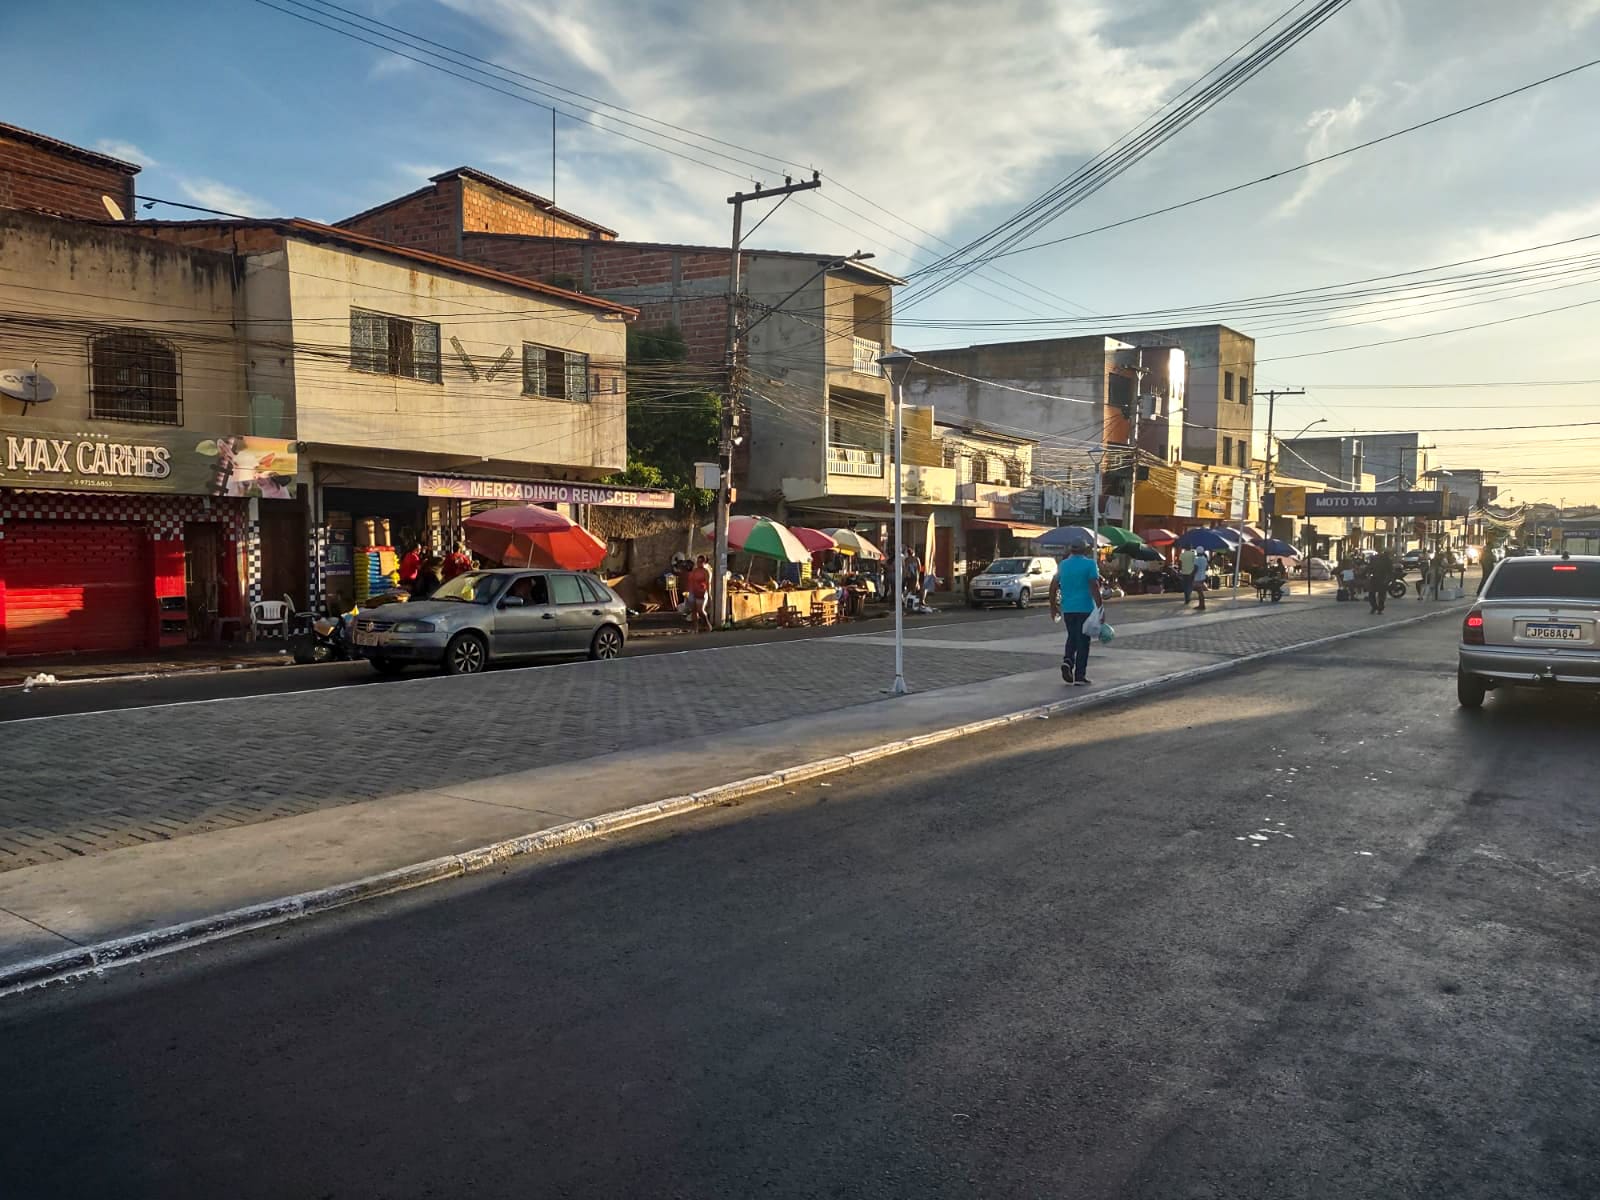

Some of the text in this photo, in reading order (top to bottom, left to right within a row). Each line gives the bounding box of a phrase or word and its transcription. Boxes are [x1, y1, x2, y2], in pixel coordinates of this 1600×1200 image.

[6, 436, 171, 478] MAX CARNES
[470, 481, 568, 502] MERCADINHO
[572, 491, 638, 505] RENASCER
[1316, 497, 1377, 507] MOTO TAXI
[1531, 628, 1575, 638] JPG8A84
